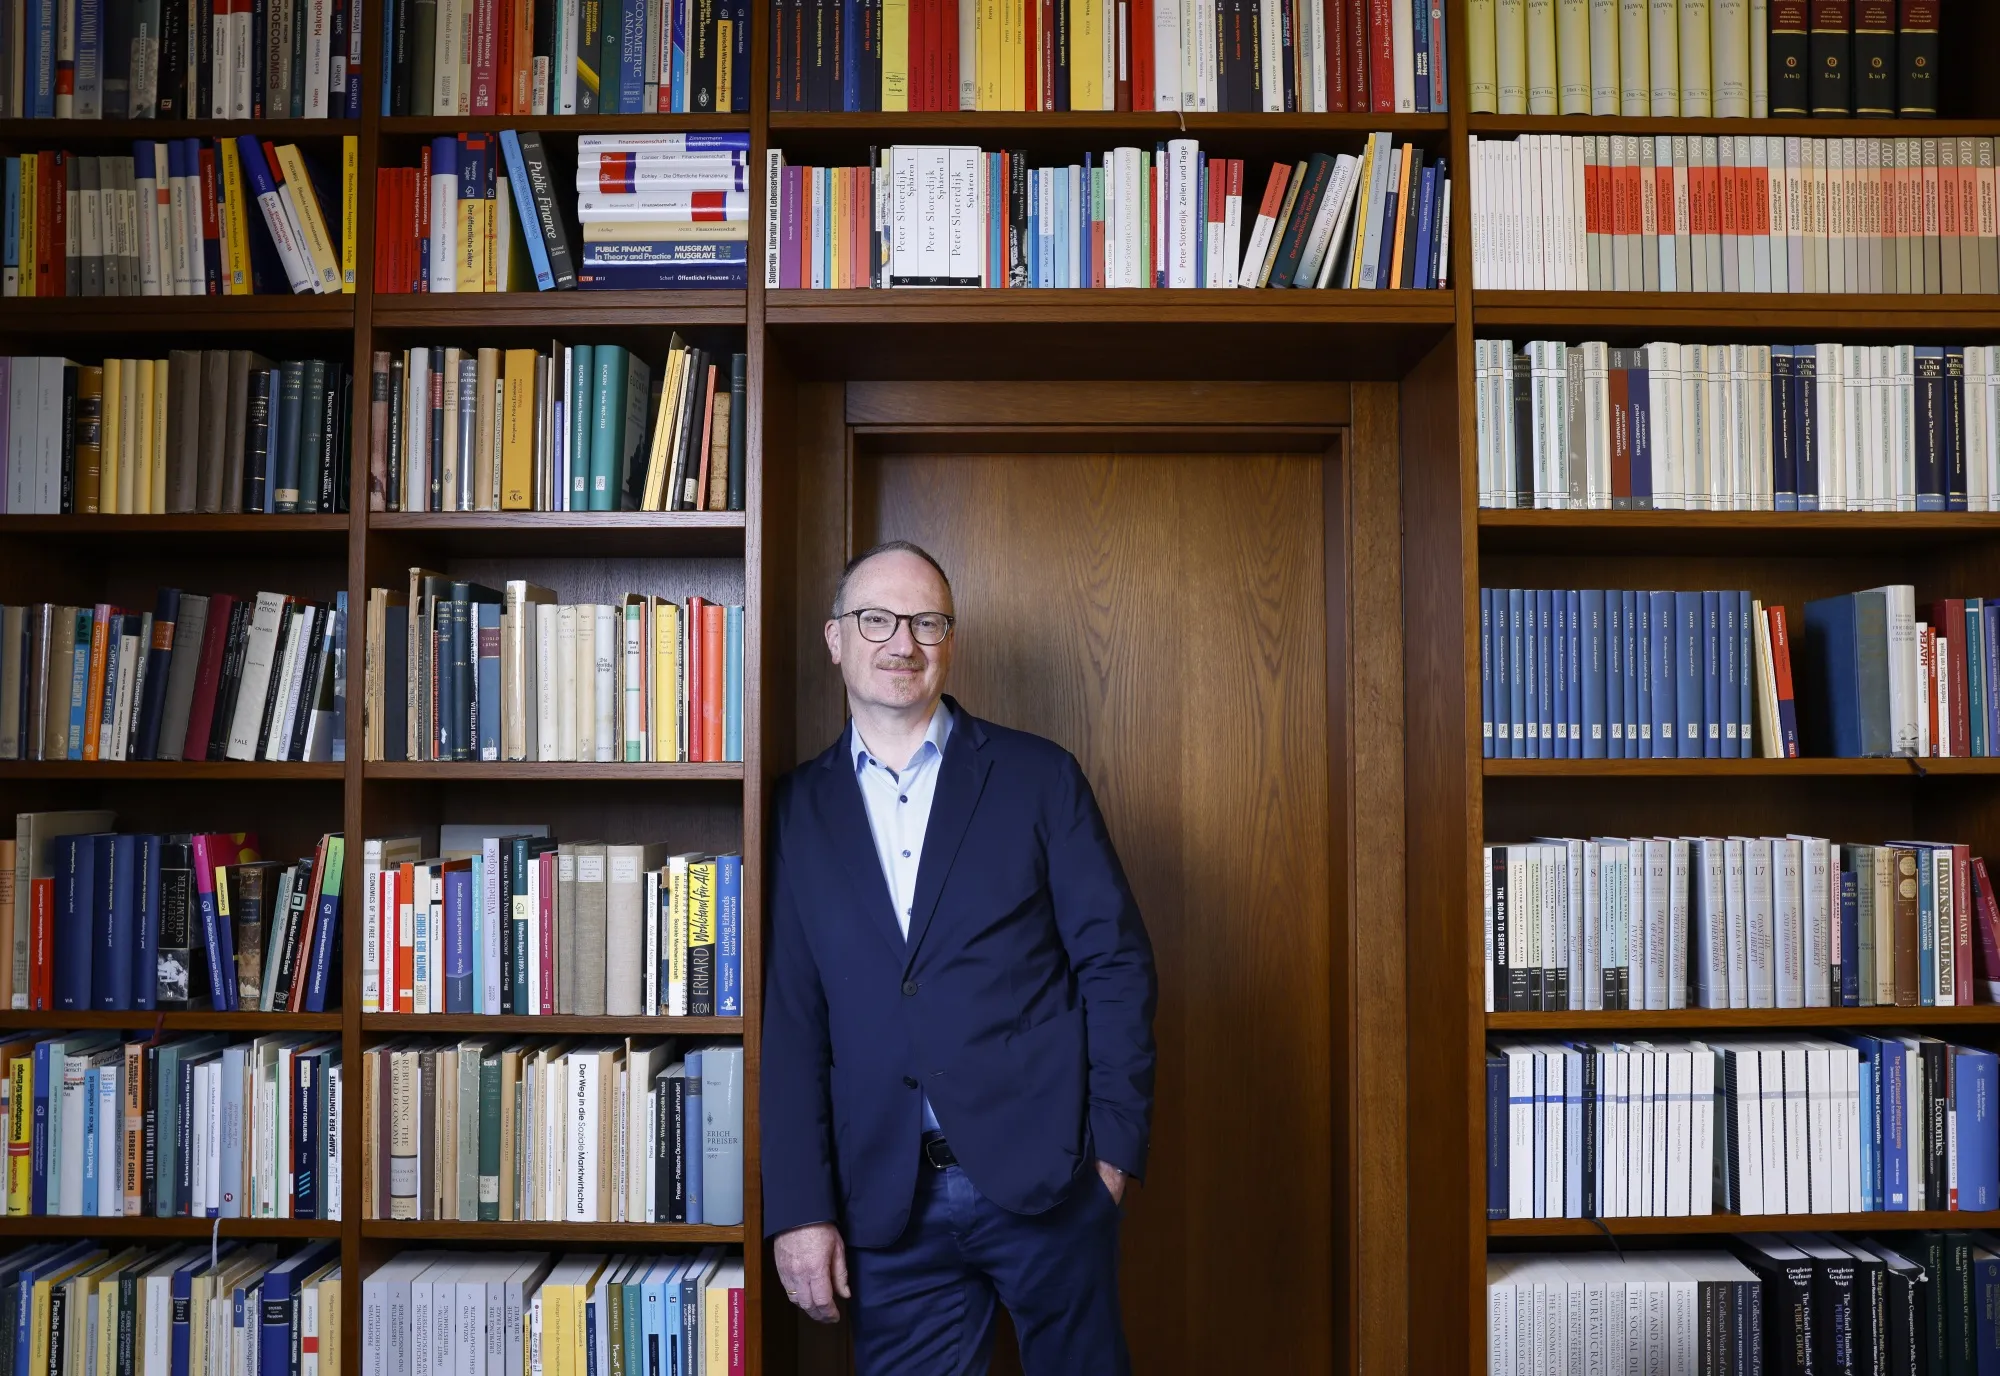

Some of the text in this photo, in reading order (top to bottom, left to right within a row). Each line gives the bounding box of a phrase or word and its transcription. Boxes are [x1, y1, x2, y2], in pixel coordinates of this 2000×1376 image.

[335, 14, 343, 35] Spahn
[624, 10, 634, 63] ANALYSIS
[81, 47, 95, 80] THEORY
[334, 65, 342, 87] Vahlen
[720, 52, 728, 102] Wirtschaftsforschung
[518, 71, 527, 106] Papermac
[1180, 146, 1188, 164] Tage
[1675, 138, 1685, 159] 1993
[1882, 142, 1894, 167] 2007
[1910, 140, 1921, 166] 2009
[1924, 140, 1935, 165] 2010
[1942, 142, 1953, 165] 2011
[1961, 140, 1972, 165] 2012
[1979, 142, 1991, 166] 2013
[257, 174, 266, 191] Fritsch
[770, 154, 778, 208] Lebenserfahrung
[937, 167, 946, 200] Sphären
[966, 172, 976, 208] Sphären
[528, 160, 557, 239] Public Finance
[896, 169, 908, 252] Peter Sloterdijk
[925, 170, 938, 252] Peter Sloterdijk
[951, 171, 964, 256] Peter Sloterdijk
[769, 222, 777, 250] Literatur
[1179, 210, 1188, 246] Sloterdijk
[604, 253, 629, 261] Theory
[768, 252, 777, 284] Sloterdijk
[326, 391, 334, 424] PRINCIPLES
[74, 649, 86, 674] CAPITAL
[1920, 630, 1928, 666] HAYEK
[72, 679, 84, 707] GROWTH
[70, 725, 81, 750] OXFORD
[234, 738, 248, 746] YALE
[486, 848, 497, 915] Wilhelm Röpke
[1710, 866, 1722, 876] 15
[1754, 866, 1765, 876] 17
[1784, 866, 1796, 876] 18
[1813, 866, 1824, 876] 19
[176, 874, 187, 943] SCHUMPETER
[689, 865, 710, 996] ERHARD Wohlstand für Alle
[722, 927, 731, 956] Ludwig
[1497, 922, 1504, 932] TO
[1939, 862, 1951, 992] HAYEK'S CHALLENGE
[416, 913, 426, 982] FRONTEN DER FREIHEIT
[692, 1003, 710, 1014] ECON
[578, 1063, 586, 1078] Der
[577, 1079, 586, 1097] Weg
[1934, 1098, 1945, 1156] Economics
[146, 1125, 154, 1180] FADING MIRACLE
[577, 1151, 585, 1214] Marktwirtschaft
[20, 1280, 28, 1327] Wirtschaftspolitik
[1650, 1291, 1658, 1340] LAW AND
[50, 1299, 60, 1368] Flexible Exchange
[246, 1306, 254, 1341] Wirtschaft
[1630, 1315, 1638, 1353] SOCIAL
[1794, 1303, 1805, 1366] PUBLIC CHOICE
[1804, 1332, 1812, 1367] Handbook
